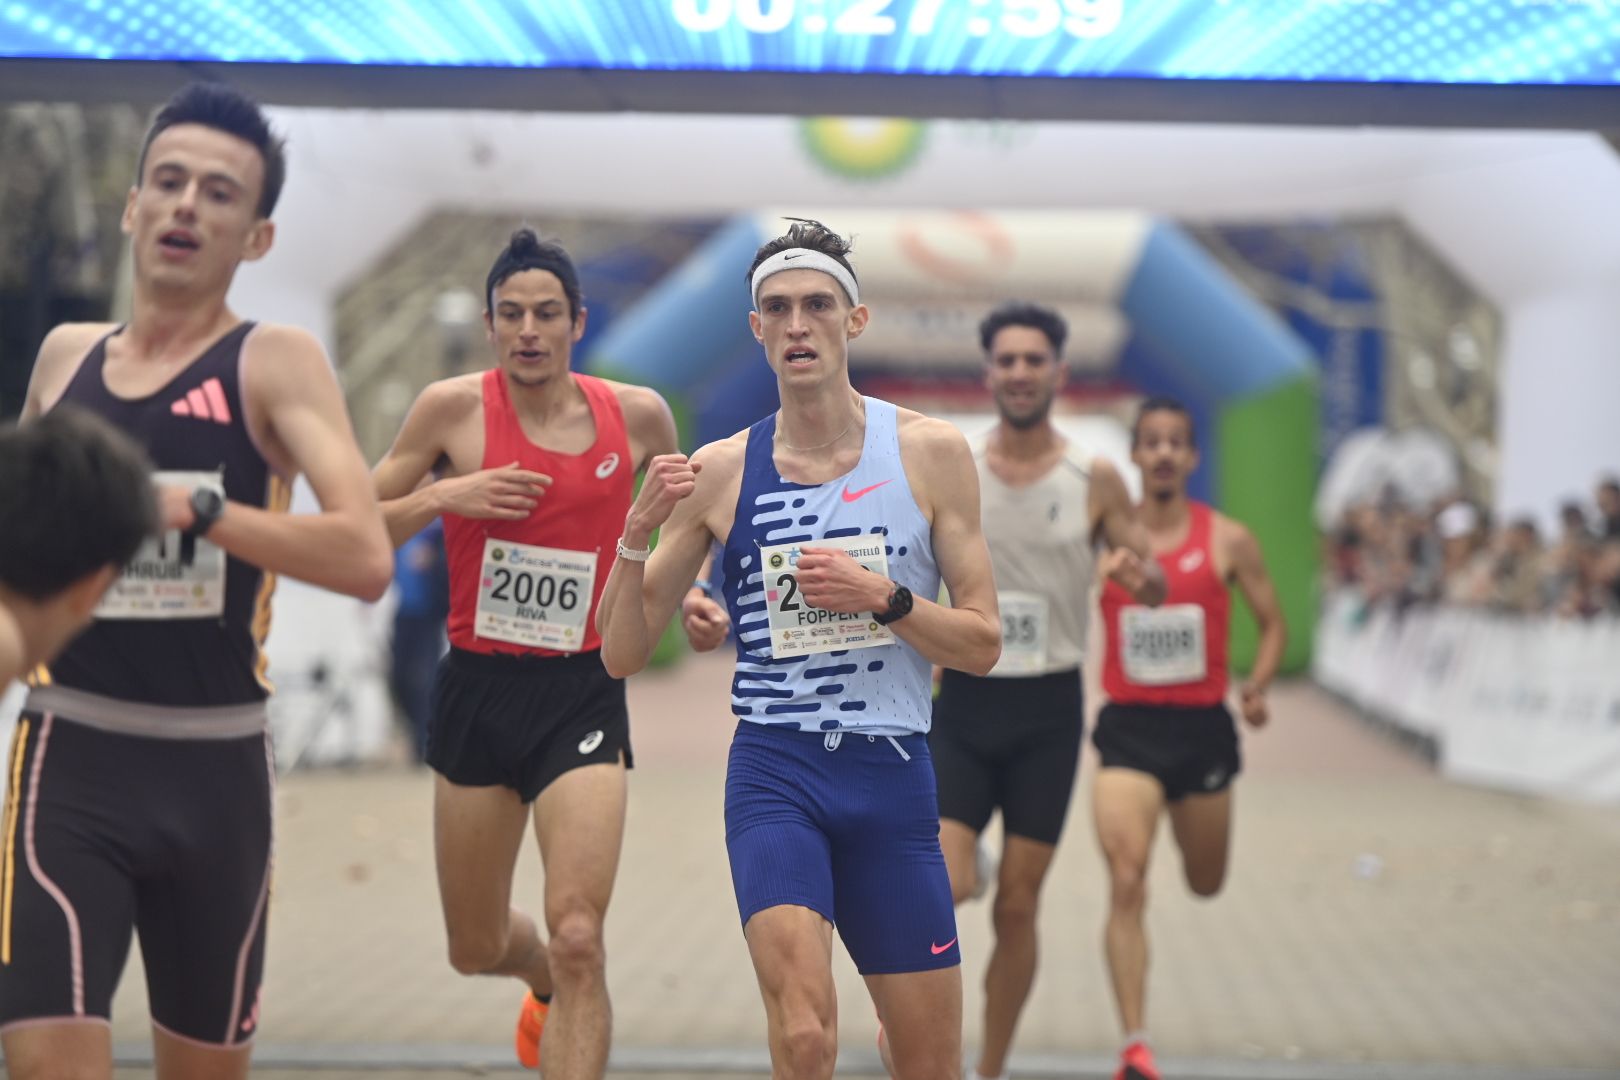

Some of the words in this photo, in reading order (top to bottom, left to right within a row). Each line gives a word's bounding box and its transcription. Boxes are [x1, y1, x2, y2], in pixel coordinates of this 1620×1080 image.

[844, 546, 880, 559] ASTELLÓ
[126, 561, 184, 579] HRUB
[491, 567, 579, 612] 2006
[516, 605, 548, 621] RIVA
[797, 609, 859, 625] FOPPEN
[1002, 613, 1038, 644] 35
